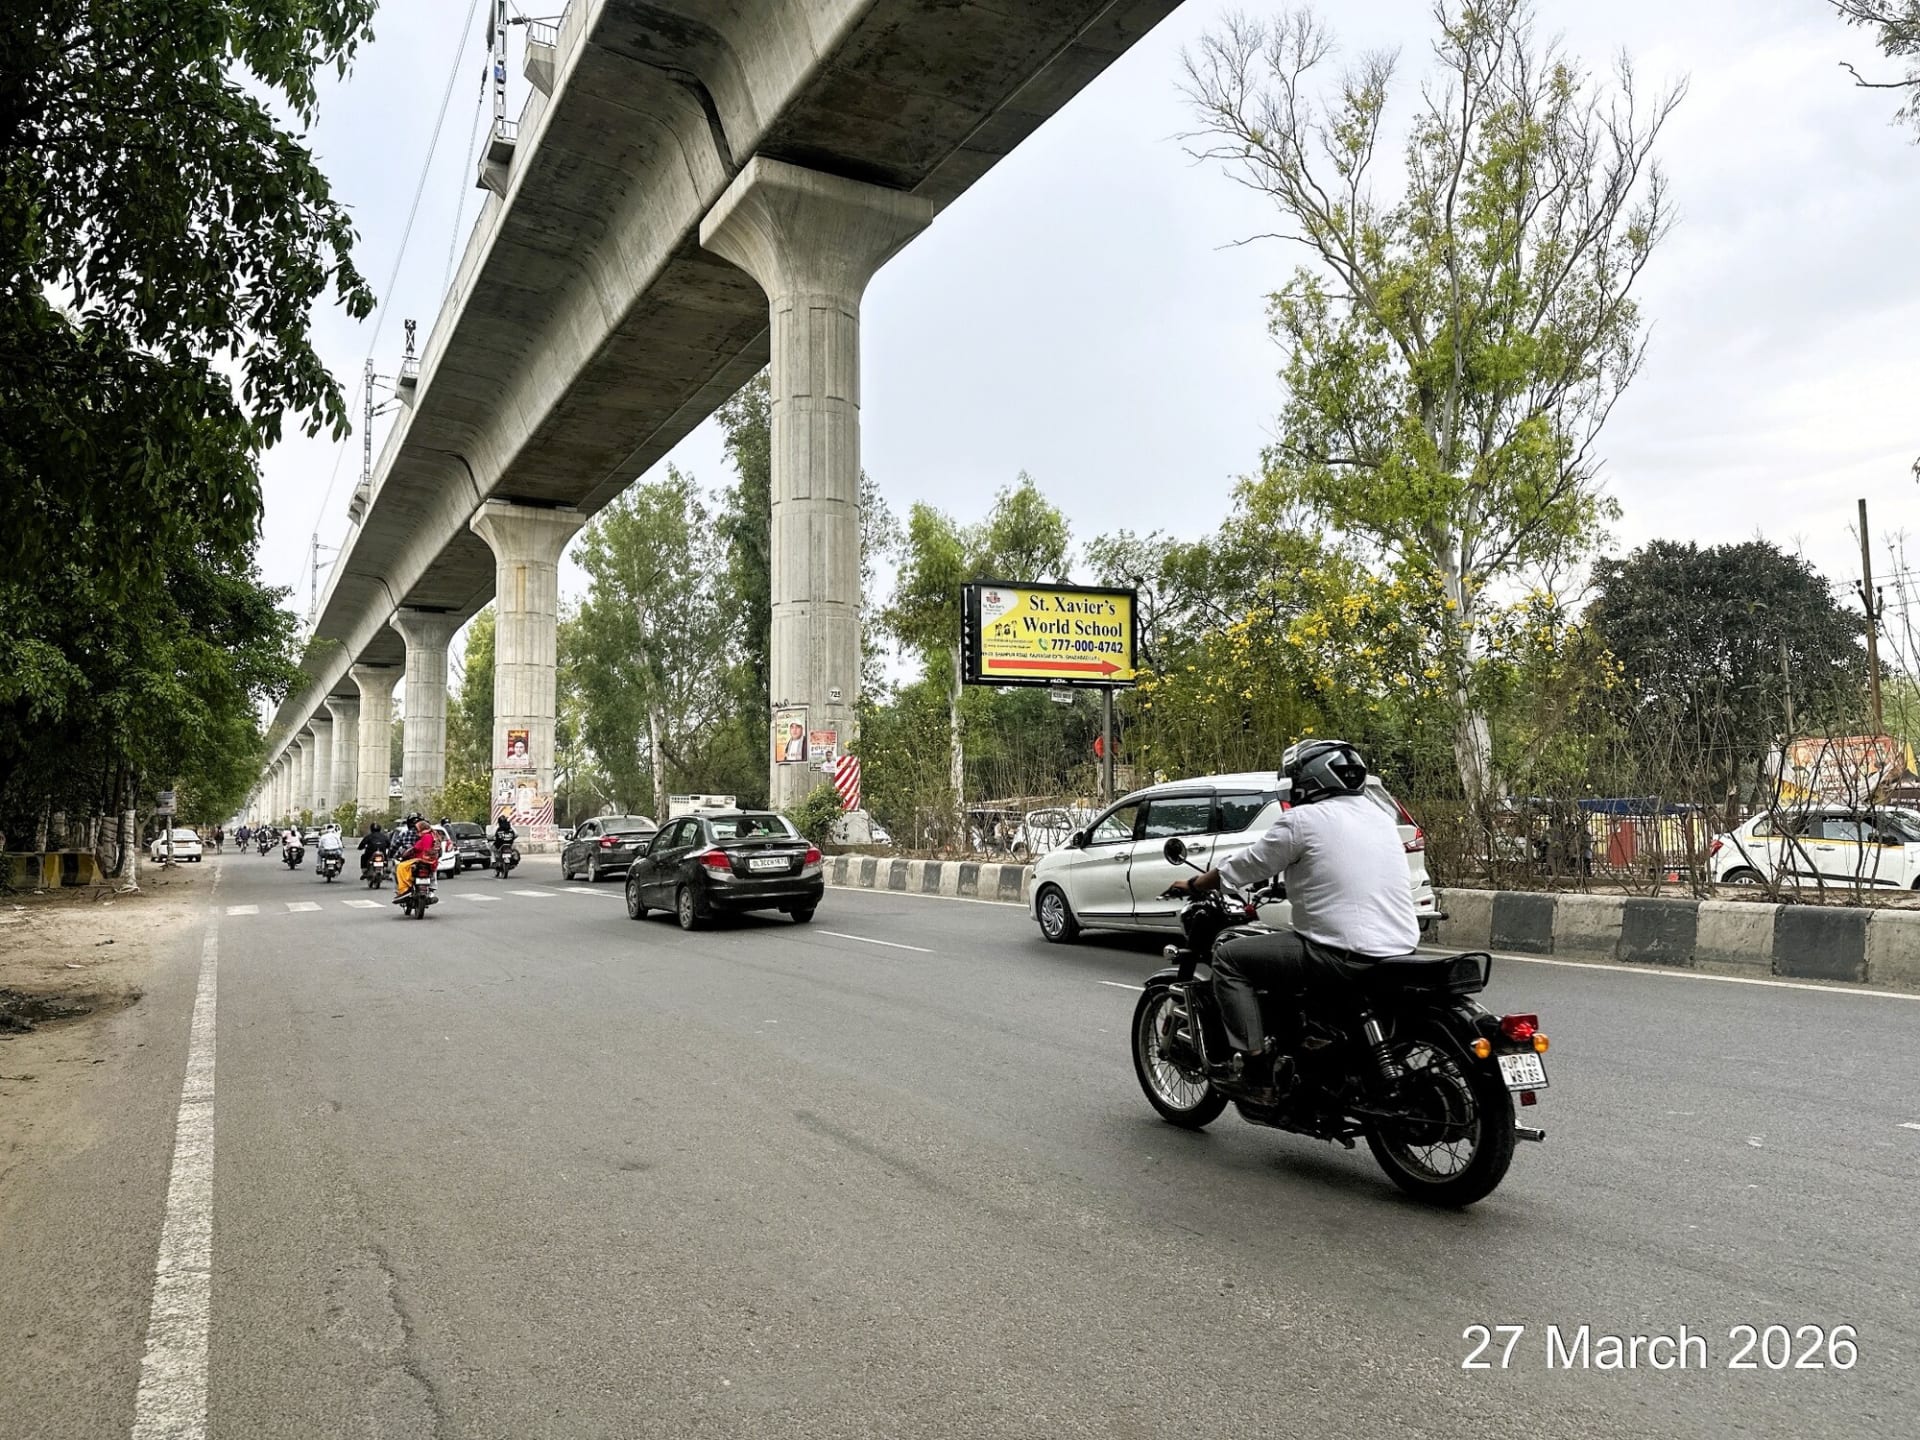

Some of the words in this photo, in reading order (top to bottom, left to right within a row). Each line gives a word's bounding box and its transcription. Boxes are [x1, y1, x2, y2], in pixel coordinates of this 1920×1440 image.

[1030, 595, 1049, 612] St.
[1055, 597, 1116, 616] Xavier's
[1023, 616, 1070, 635] World
[1075, 619, 1123, 638] School
[1051, 639, 1123, 654] 777-000-4742
